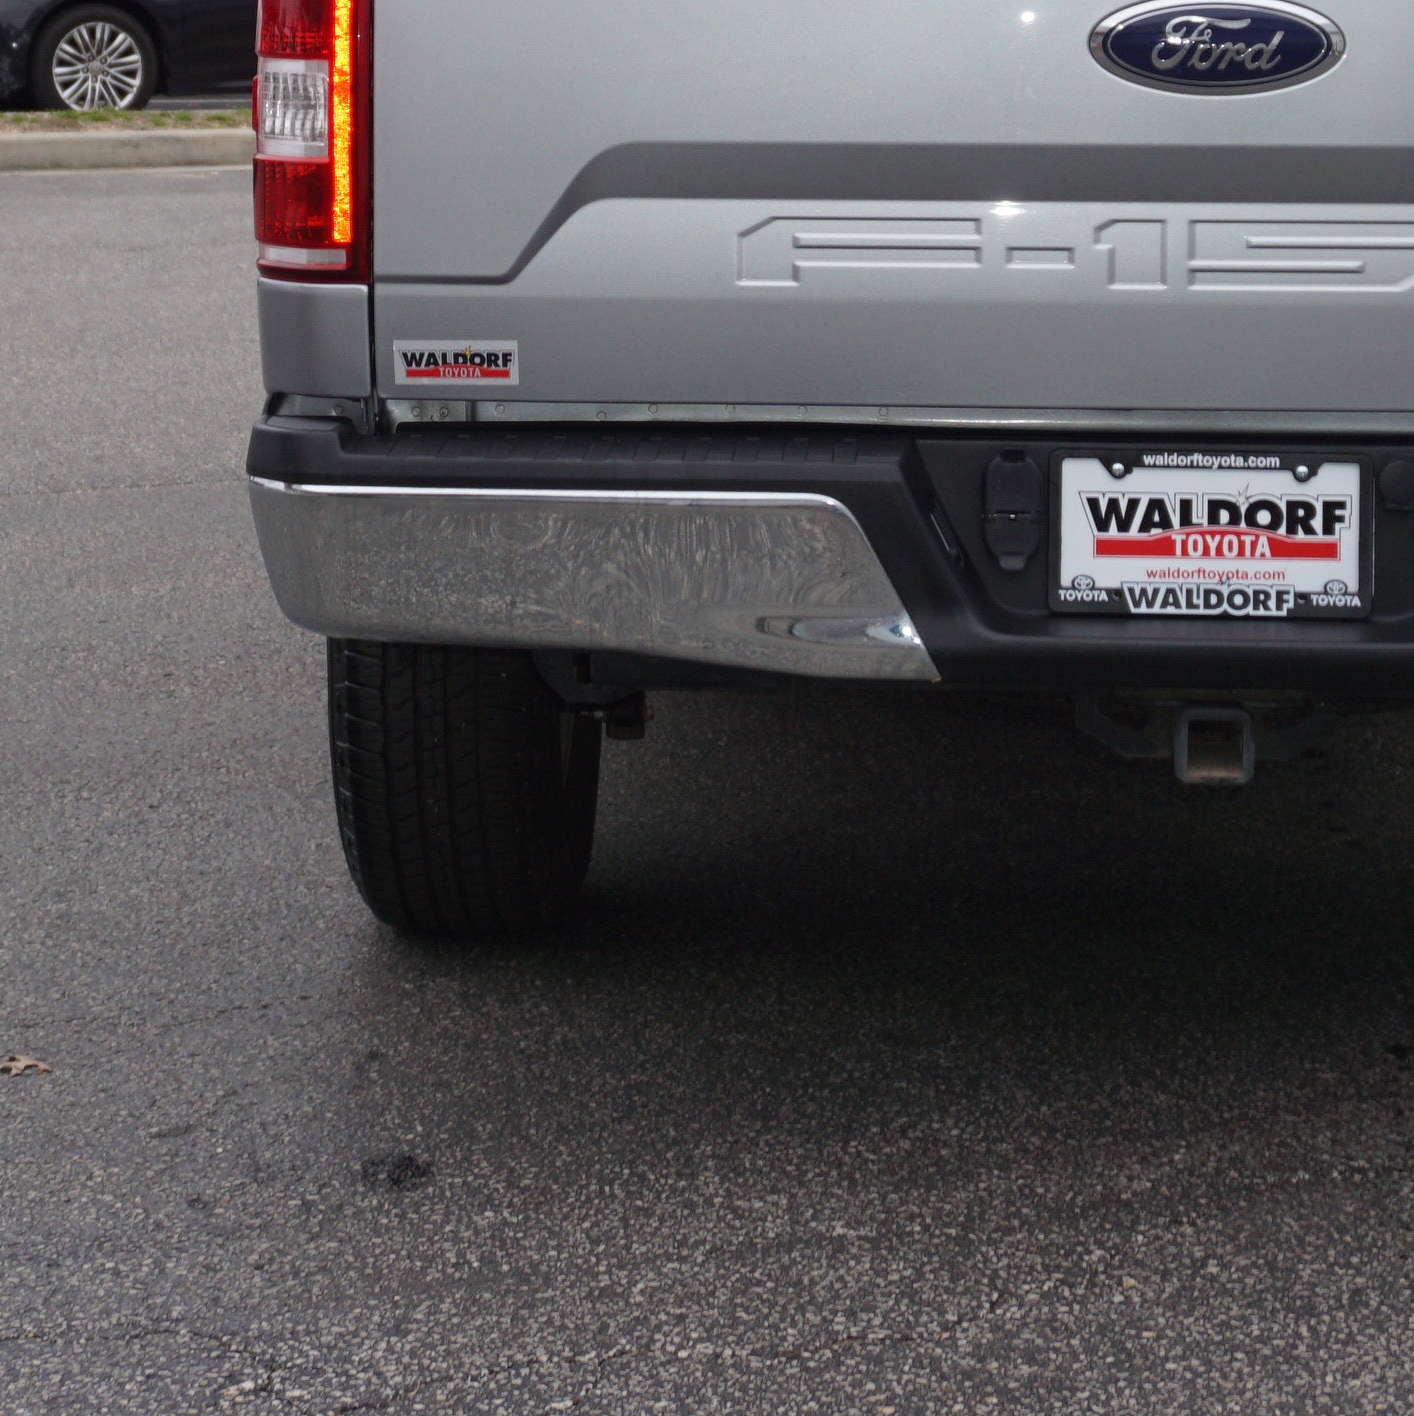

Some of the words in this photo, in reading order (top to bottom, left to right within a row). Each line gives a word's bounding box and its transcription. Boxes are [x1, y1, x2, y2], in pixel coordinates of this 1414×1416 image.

[1151, 15, 1285, 71] Ford
[401, 351, 513, 368] WALDORF
[439, 367, 481, 378] TOYOTA
[1143, 452, 1280, 469] waldorftoyota.com
[1085, 496, 1348, 537] WALDORF
[1172, 534, 1272, 558] TOYOTA
[1146, 567, 1286, 582] waldorftoyota.com
[1059, 588, 1109, 602] TOYOTA
[1126, 586, 1293, 612] WALDORF
[1311, 594, 1362, 608] TOYOTA
